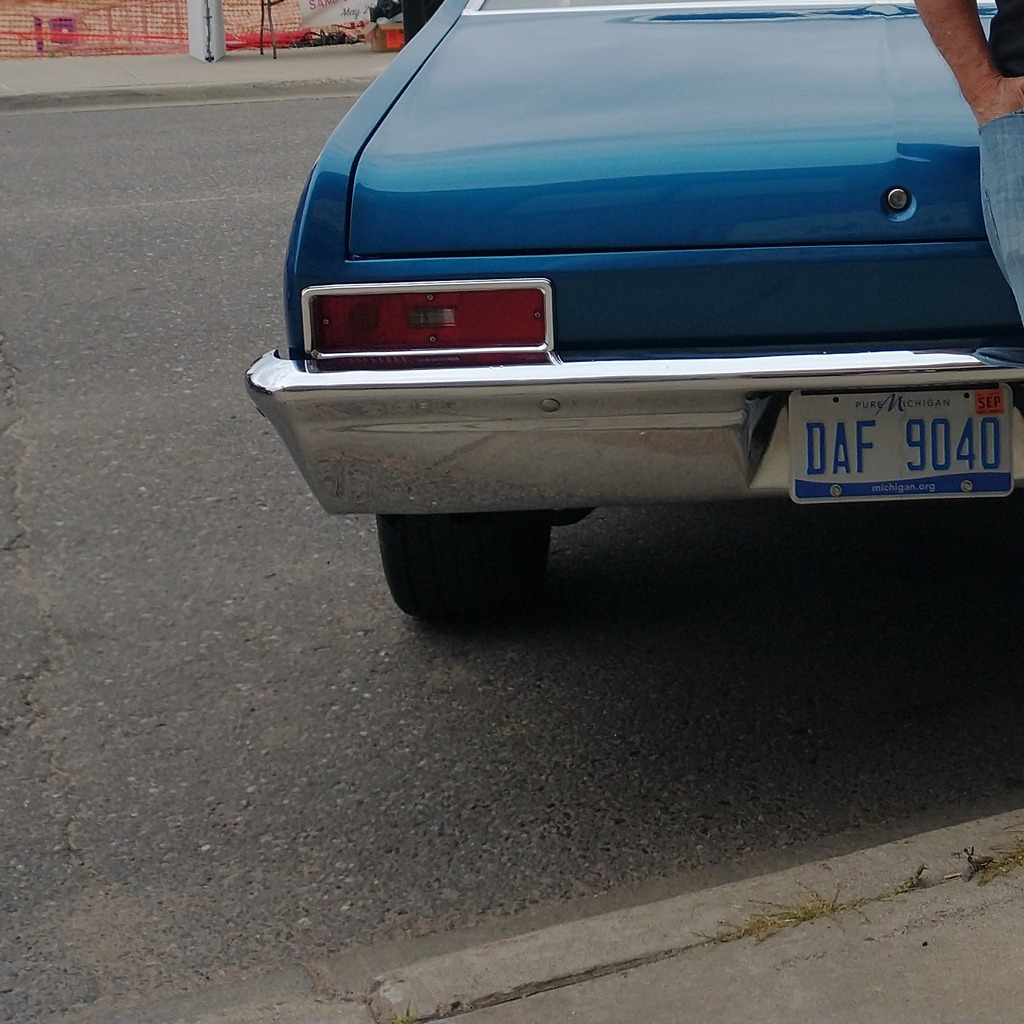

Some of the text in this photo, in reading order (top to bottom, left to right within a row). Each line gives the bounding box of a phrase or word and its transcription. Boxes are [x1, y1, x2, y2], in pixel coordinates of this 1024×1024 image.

[341, 7, 360, 20] May
[855, 400, 883, 409] PURE
[978, 396, 1001, 409] SEP
[806, 417, 1000, 475] DAF 9040
[872, 481, 936, 493] michigan.org
